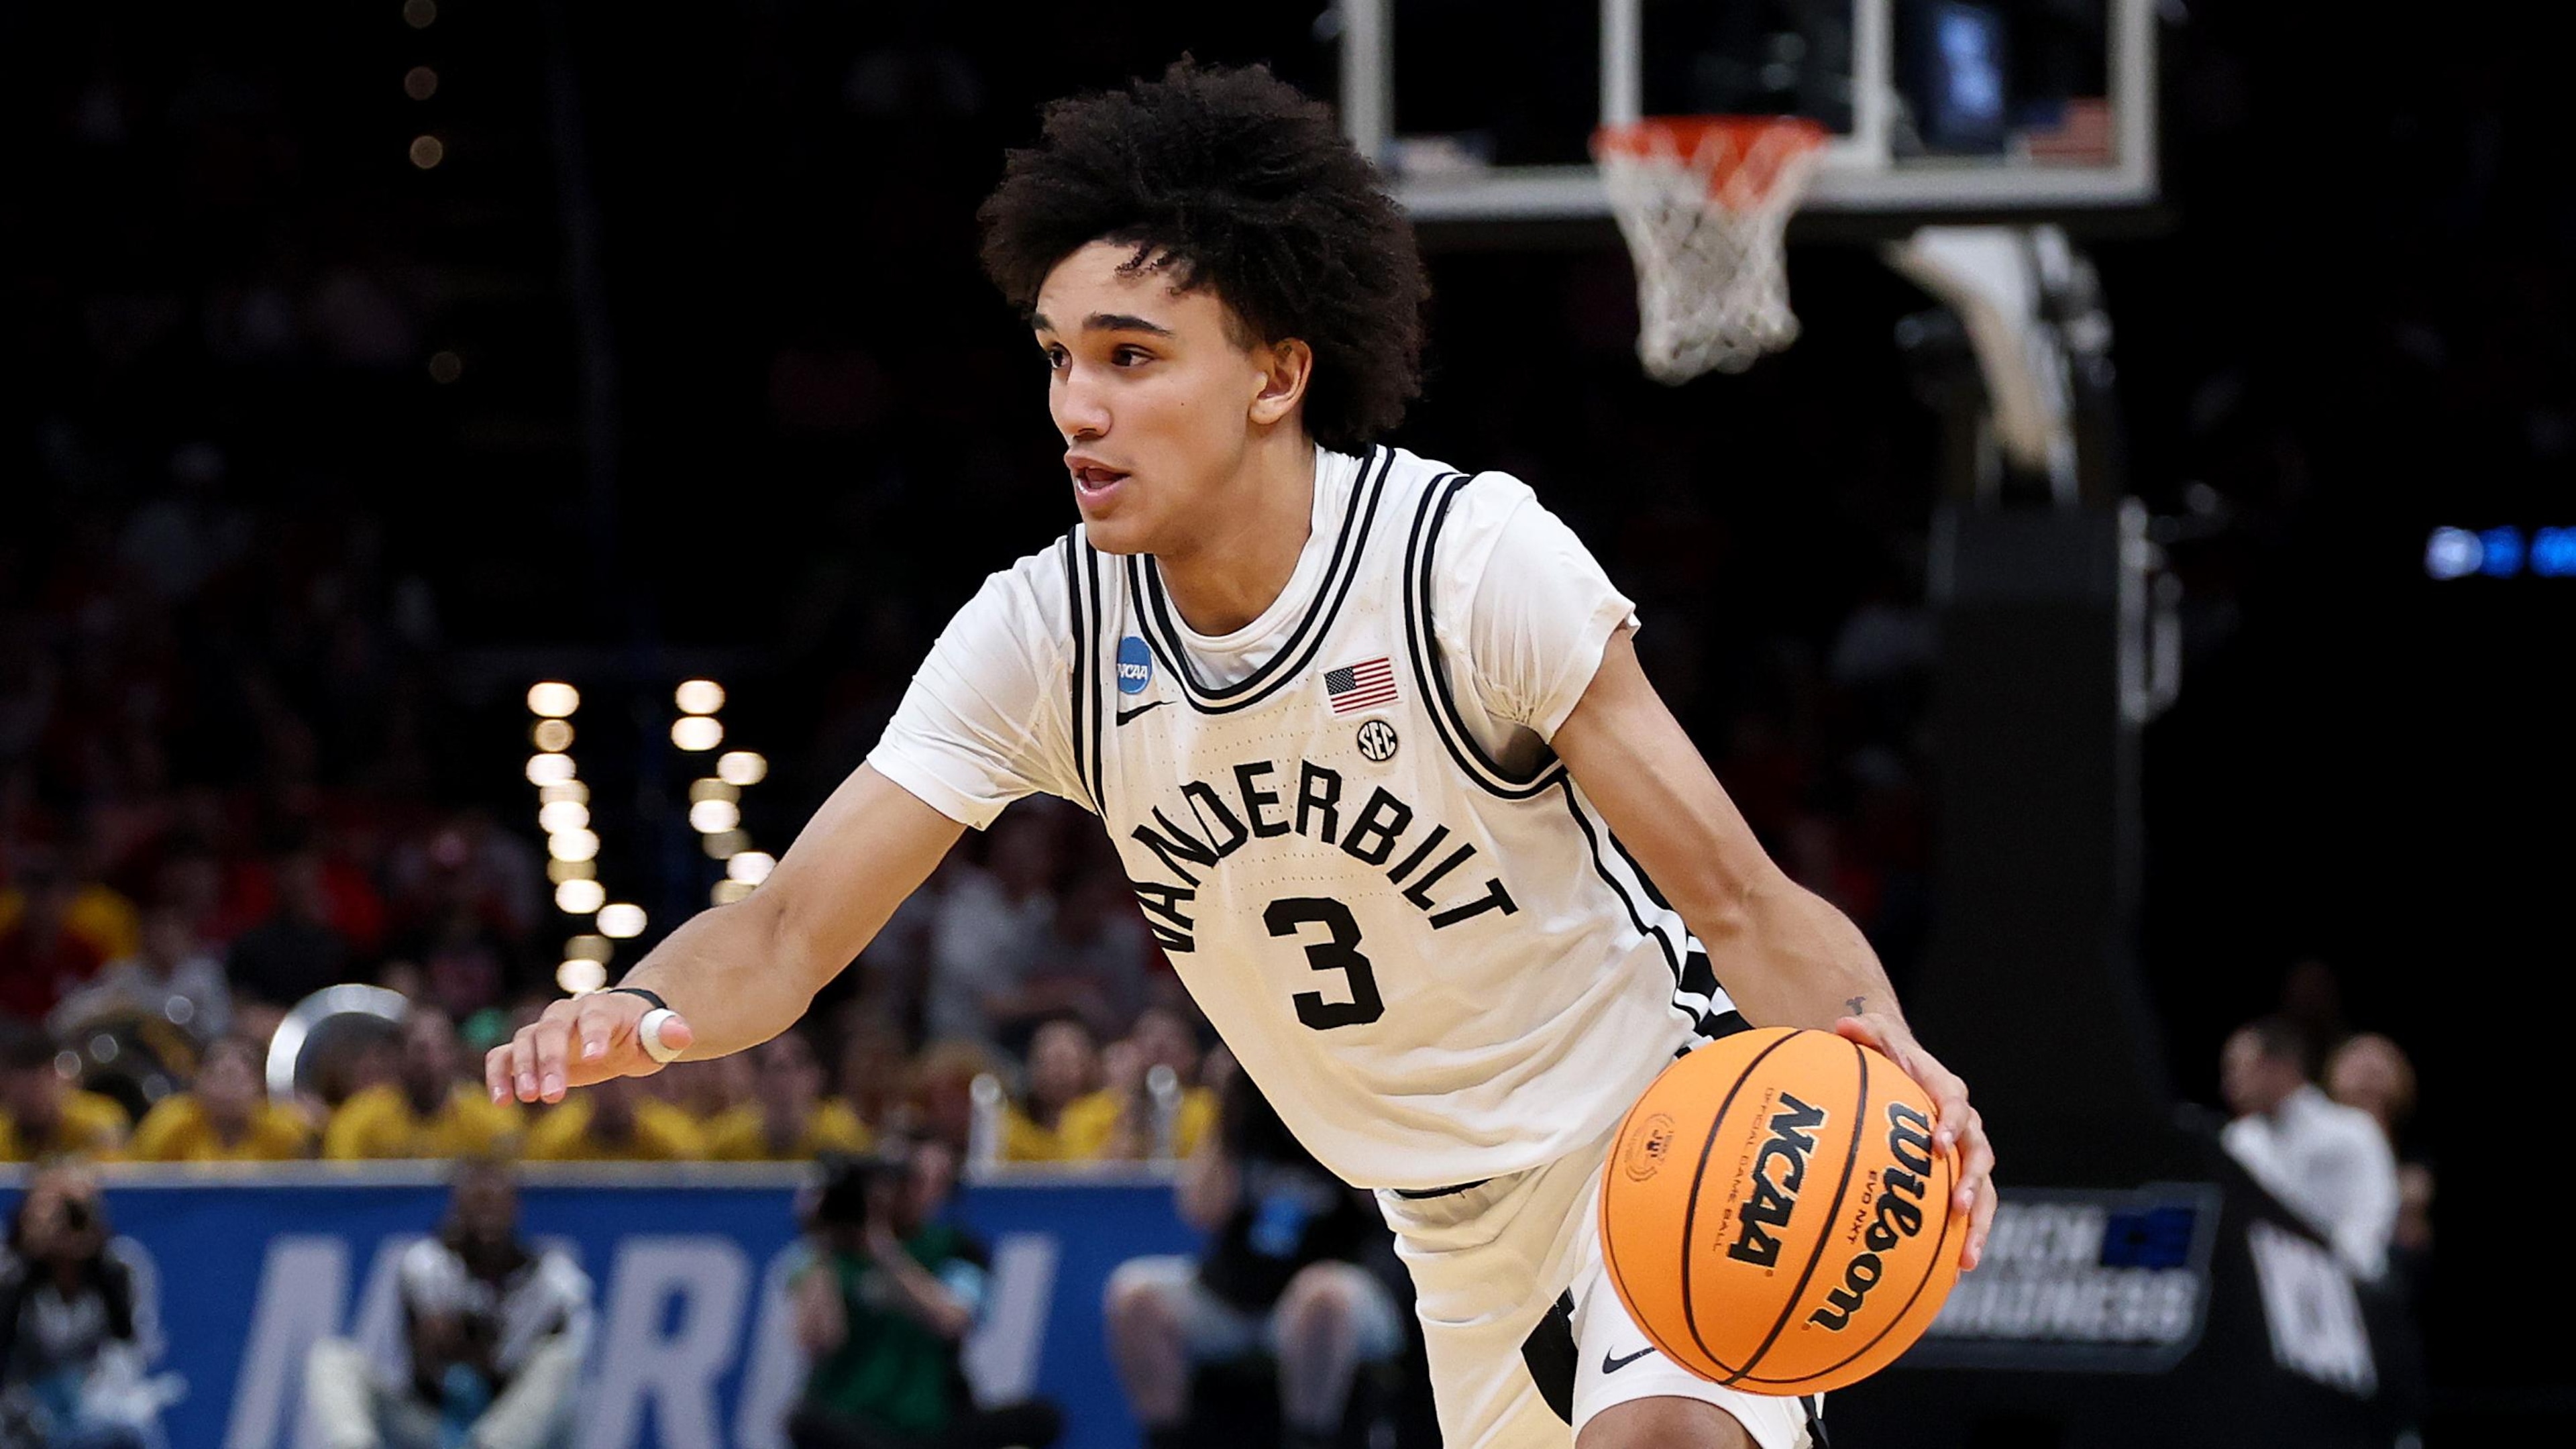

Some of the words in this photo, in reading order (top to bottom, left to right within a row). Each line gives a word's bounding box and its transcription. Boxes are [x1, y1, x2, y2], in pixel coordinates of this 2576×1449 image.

[1117, 663, 1148, 681] NCAA
[1358, 722, 1396, 759] SEC
[1132, 759, 1519, 953] VANDERBILT
[1263, 897, 1385, 1030] 3
[1747, 1087, 1774, 1146] OFFICIAL
[1727, 1155, 1749, 1203] GAME
[1727, 1091, 1826, 1268] NCAA
[1862, 1170, 1878, 1204] EVO
[1713, 1208, 1732, 1252] BALL
[1807, 1102, 1933, 1331] Wilson
[1847, 1209, 1867, 1244] NXT
